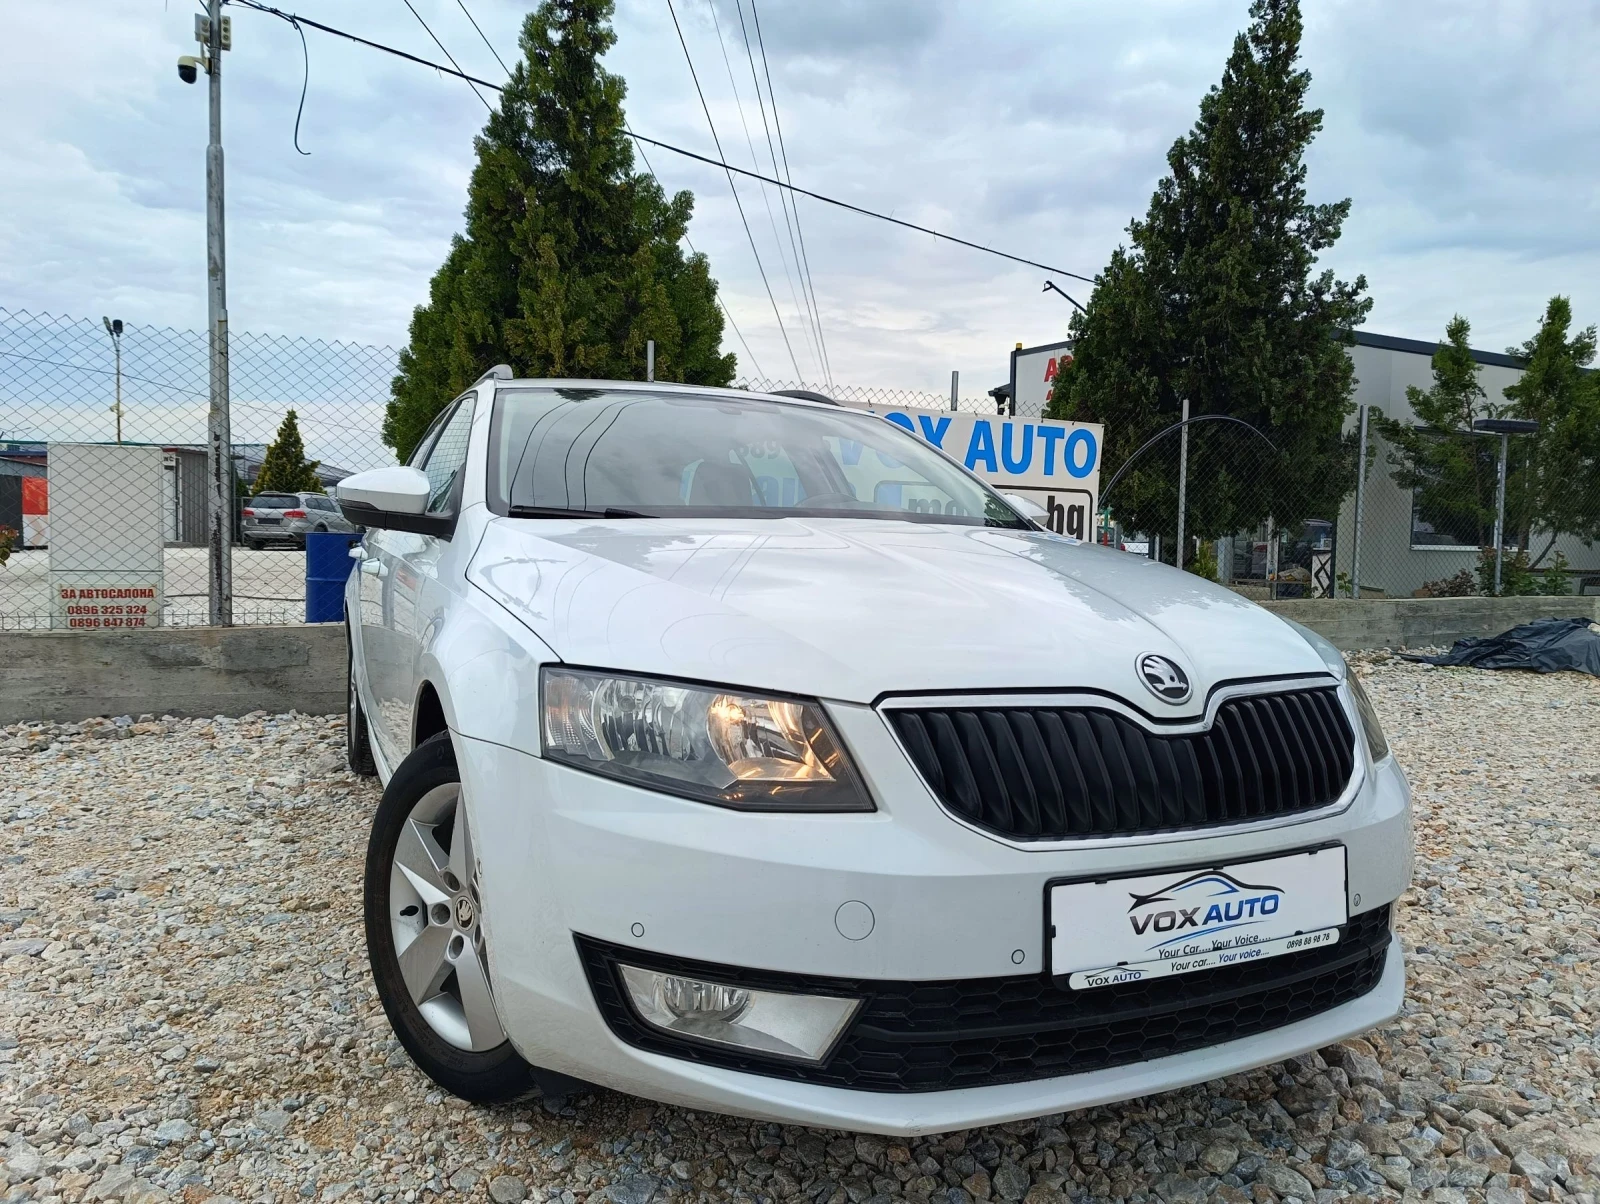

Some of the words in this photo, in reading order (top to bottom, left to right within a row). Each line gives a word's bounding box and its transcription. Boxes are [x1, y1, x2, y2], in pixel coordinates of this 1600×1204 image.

[964, 420, 1097, 478] AUTO
[61, 588, 76, 599] ЗА
[79, 588, 154, 599] АВТОСАЛОНА
[67, 605, 99, 615] 0896
[101, 605, 123, 615] 325
[126, 605, 147, 615] 324
[69, 618, 101, 628] 0896
[103, 617, 123, 627] 847
[126, 617, 146, 627] 874
[1129, 907, 1201, 935] VOX
[1202, 894, 1279, 926] AUTO
[1286, 938, 1303, 949] 0898
[1158, 948, 1180, 959] Your
[1171, 960, 1190, 972] Your
[1219, 951, 1238, 963] Your
[1087, 976, 1110, 987] VOX
[1112, 972, 1142, 983] AUTO
